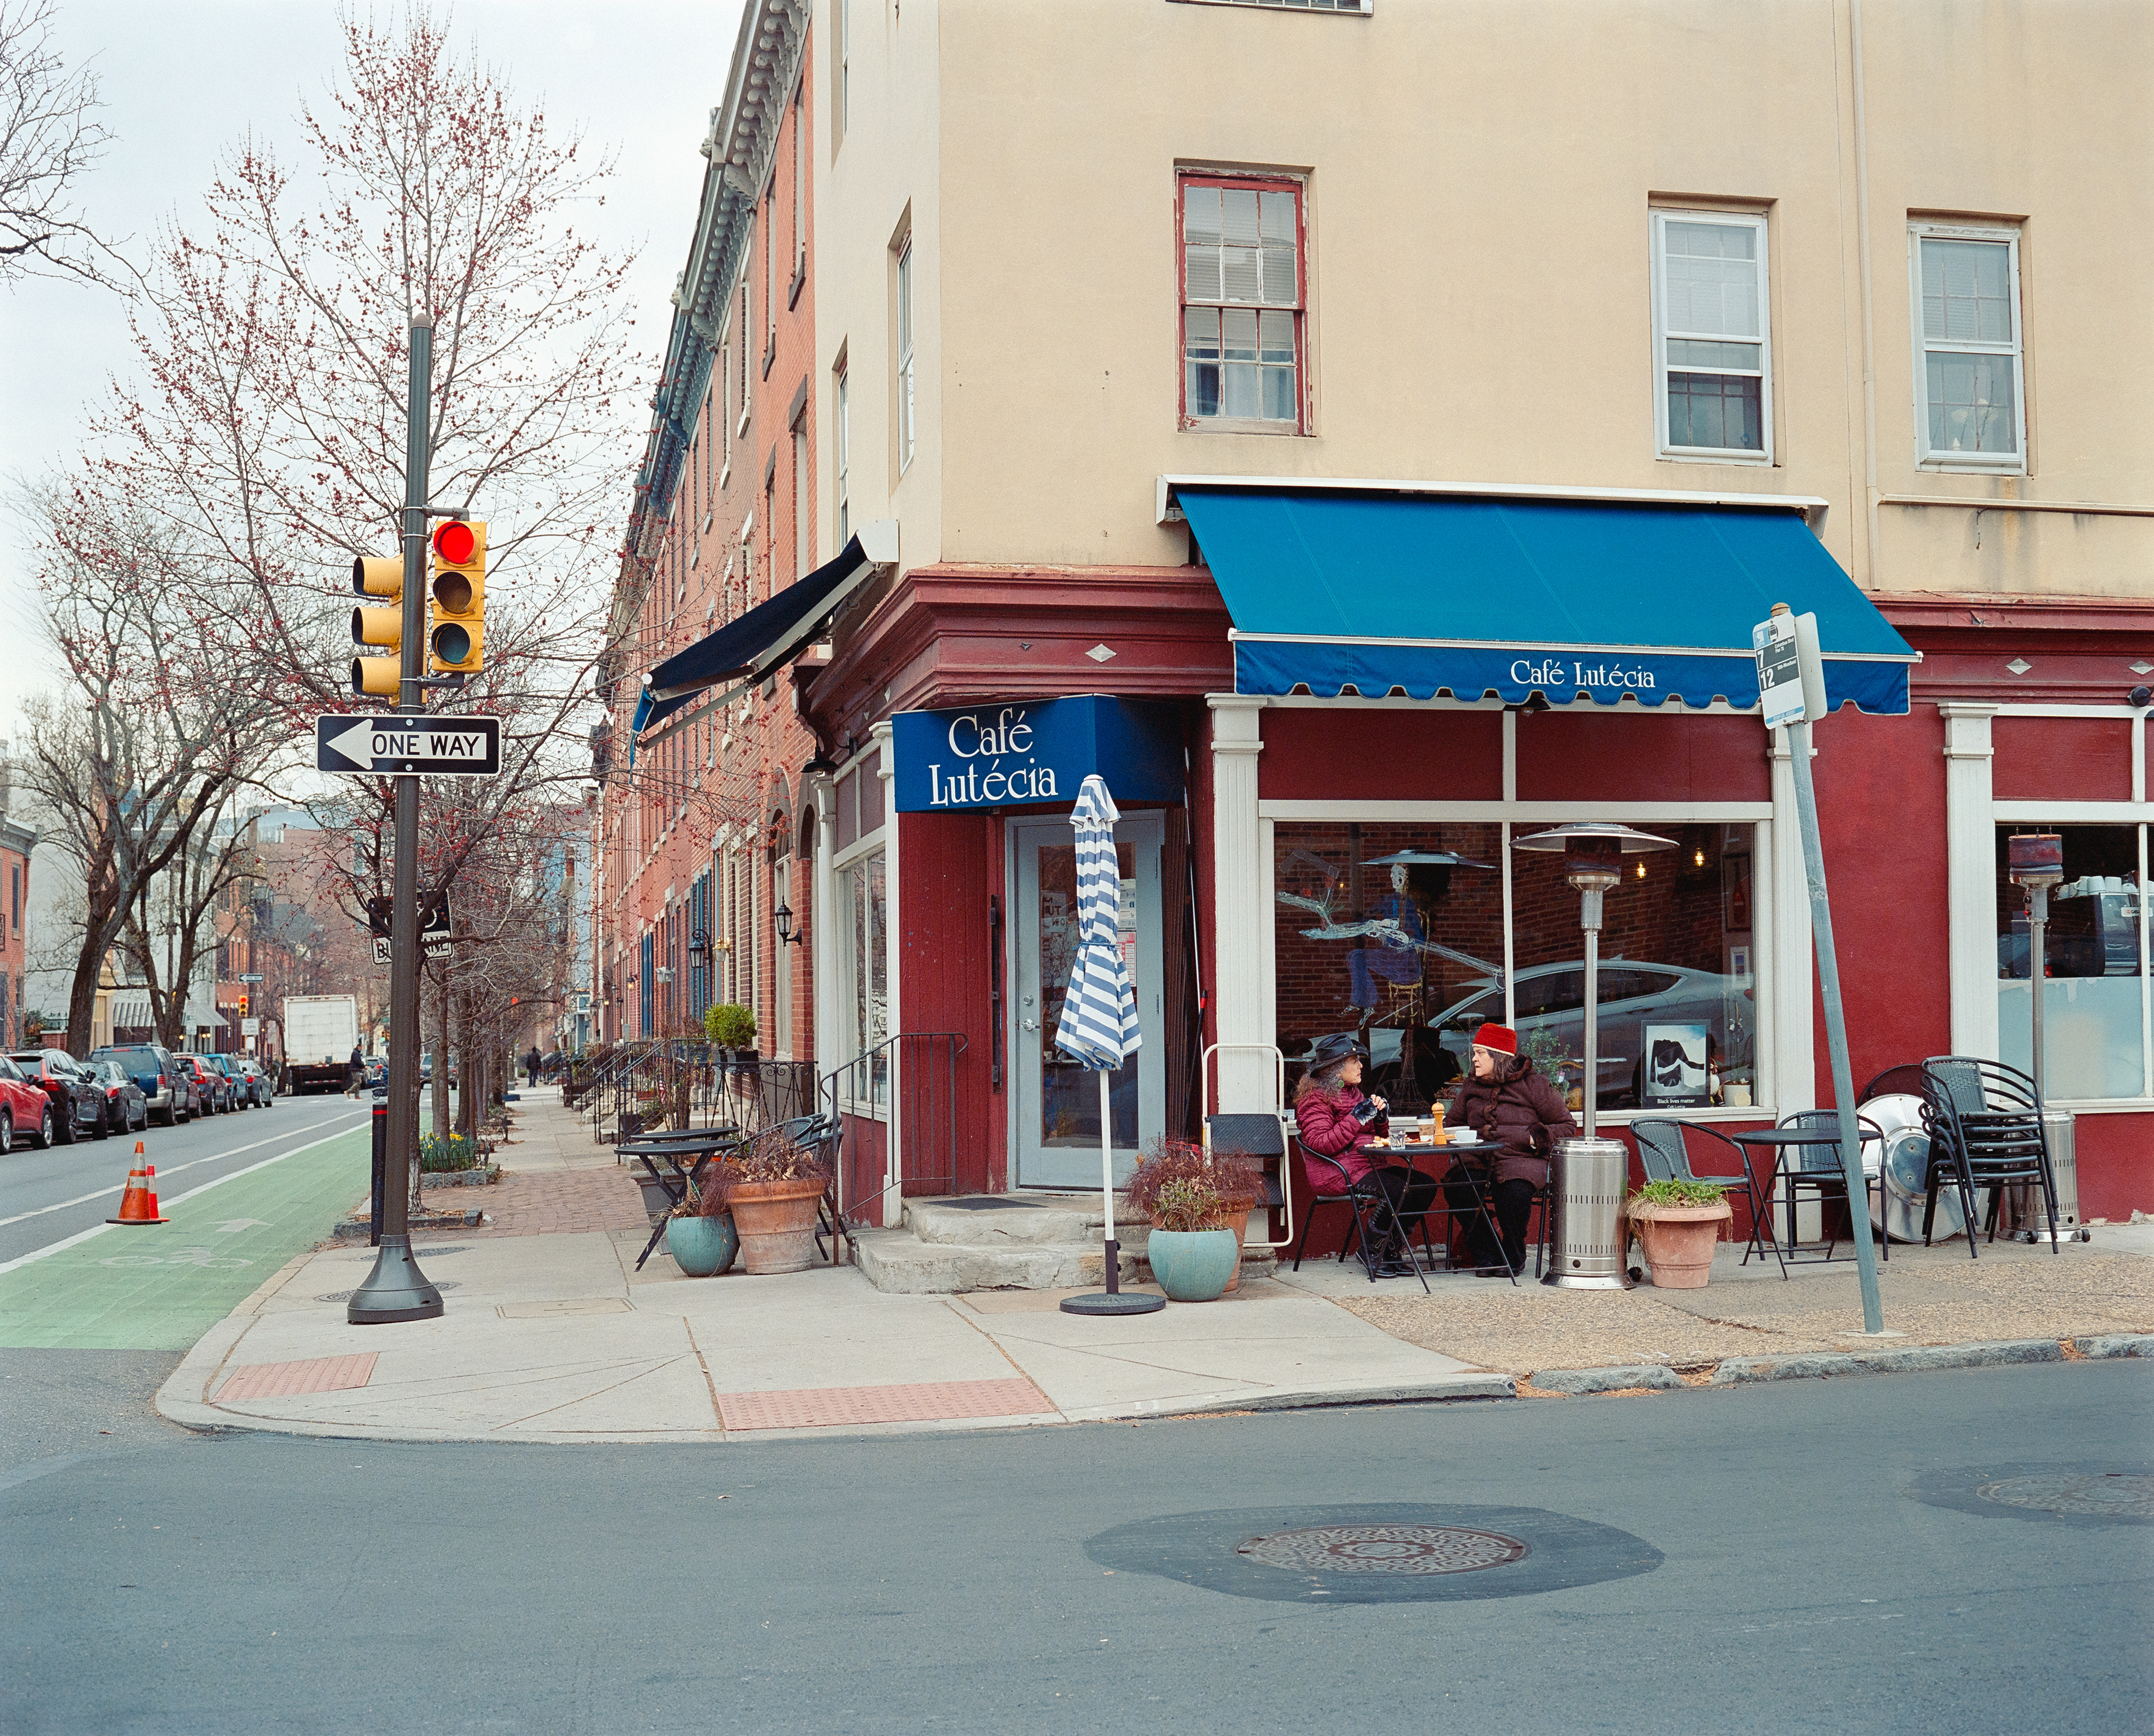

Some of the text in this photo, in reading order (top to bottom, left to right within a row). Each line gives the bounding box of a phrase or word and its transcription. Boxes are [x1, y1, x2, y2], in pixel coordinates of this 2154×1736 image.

[1757, 650, 1764, 668] 7
[1511, 659, 1656, 688] Café Lutécia
[1760, 668, 1775, 690] 12
[372, 734, 480, 757] ONE WAY
[949, 707, 1033, 758] Café
[928, 758, 1058, 806] Lutécia
